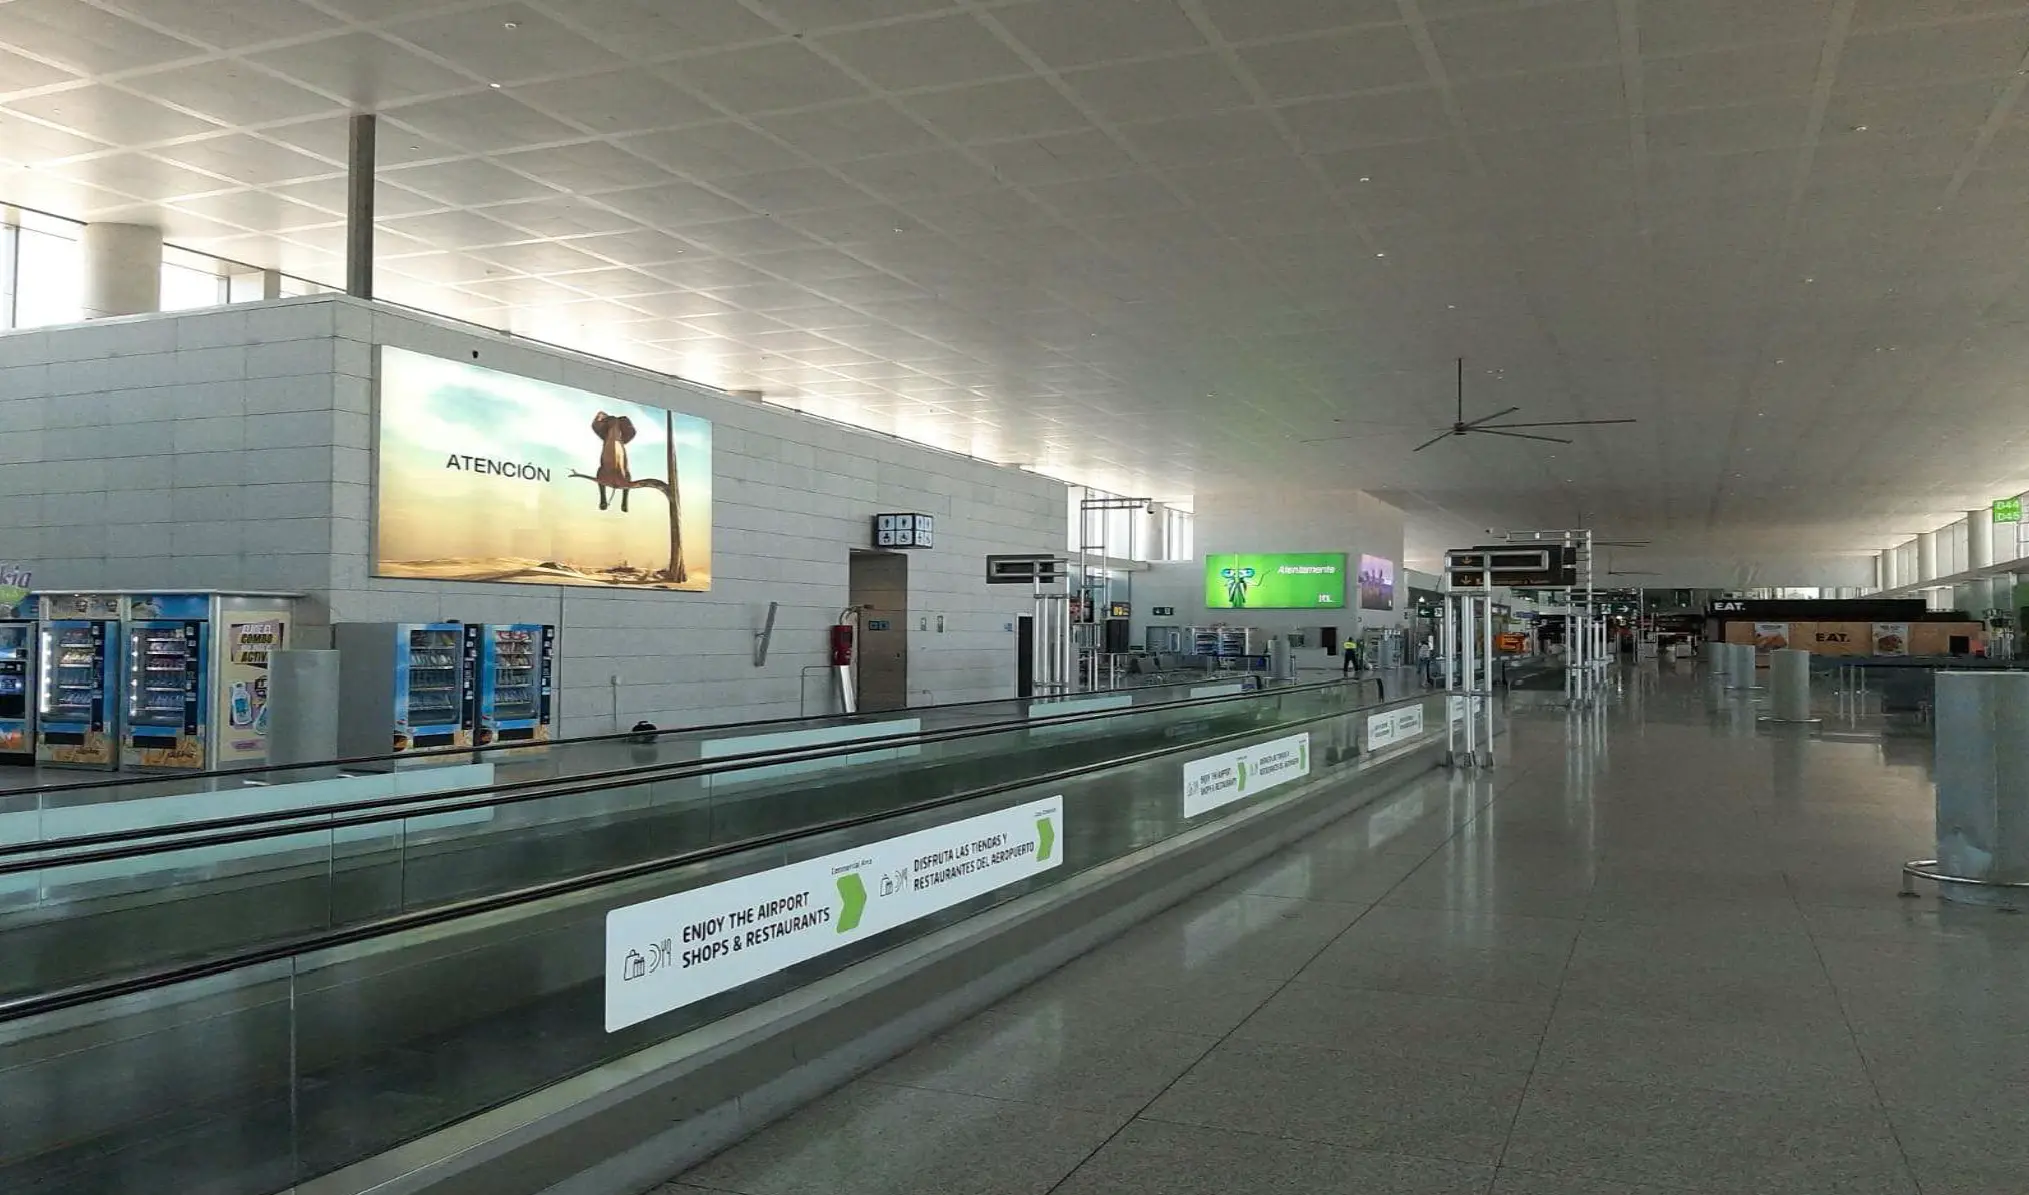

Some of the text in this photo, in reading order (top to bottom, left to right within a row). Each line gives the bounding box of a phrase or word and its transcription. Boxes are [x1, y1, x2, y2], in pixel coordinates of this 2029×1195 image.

[446, 453, 551, 482] ATENCIÓN
[1714, 602, 1746, 611] EAT.
[1815, 632, 1850, 642] EAT.
[241, 651, 268, 663] ACTIV
[914, 833, 1008, 872] DISFRUTA LAS TIENDAS Y
[914, 841, 1035, 891] RESTAURANTES DEL AEROPUERTO
[682, 891, 810, 943] ENJOY THE AIRPORT
[682, 907, 830, 968] SHOPS & RESTAURANTS
